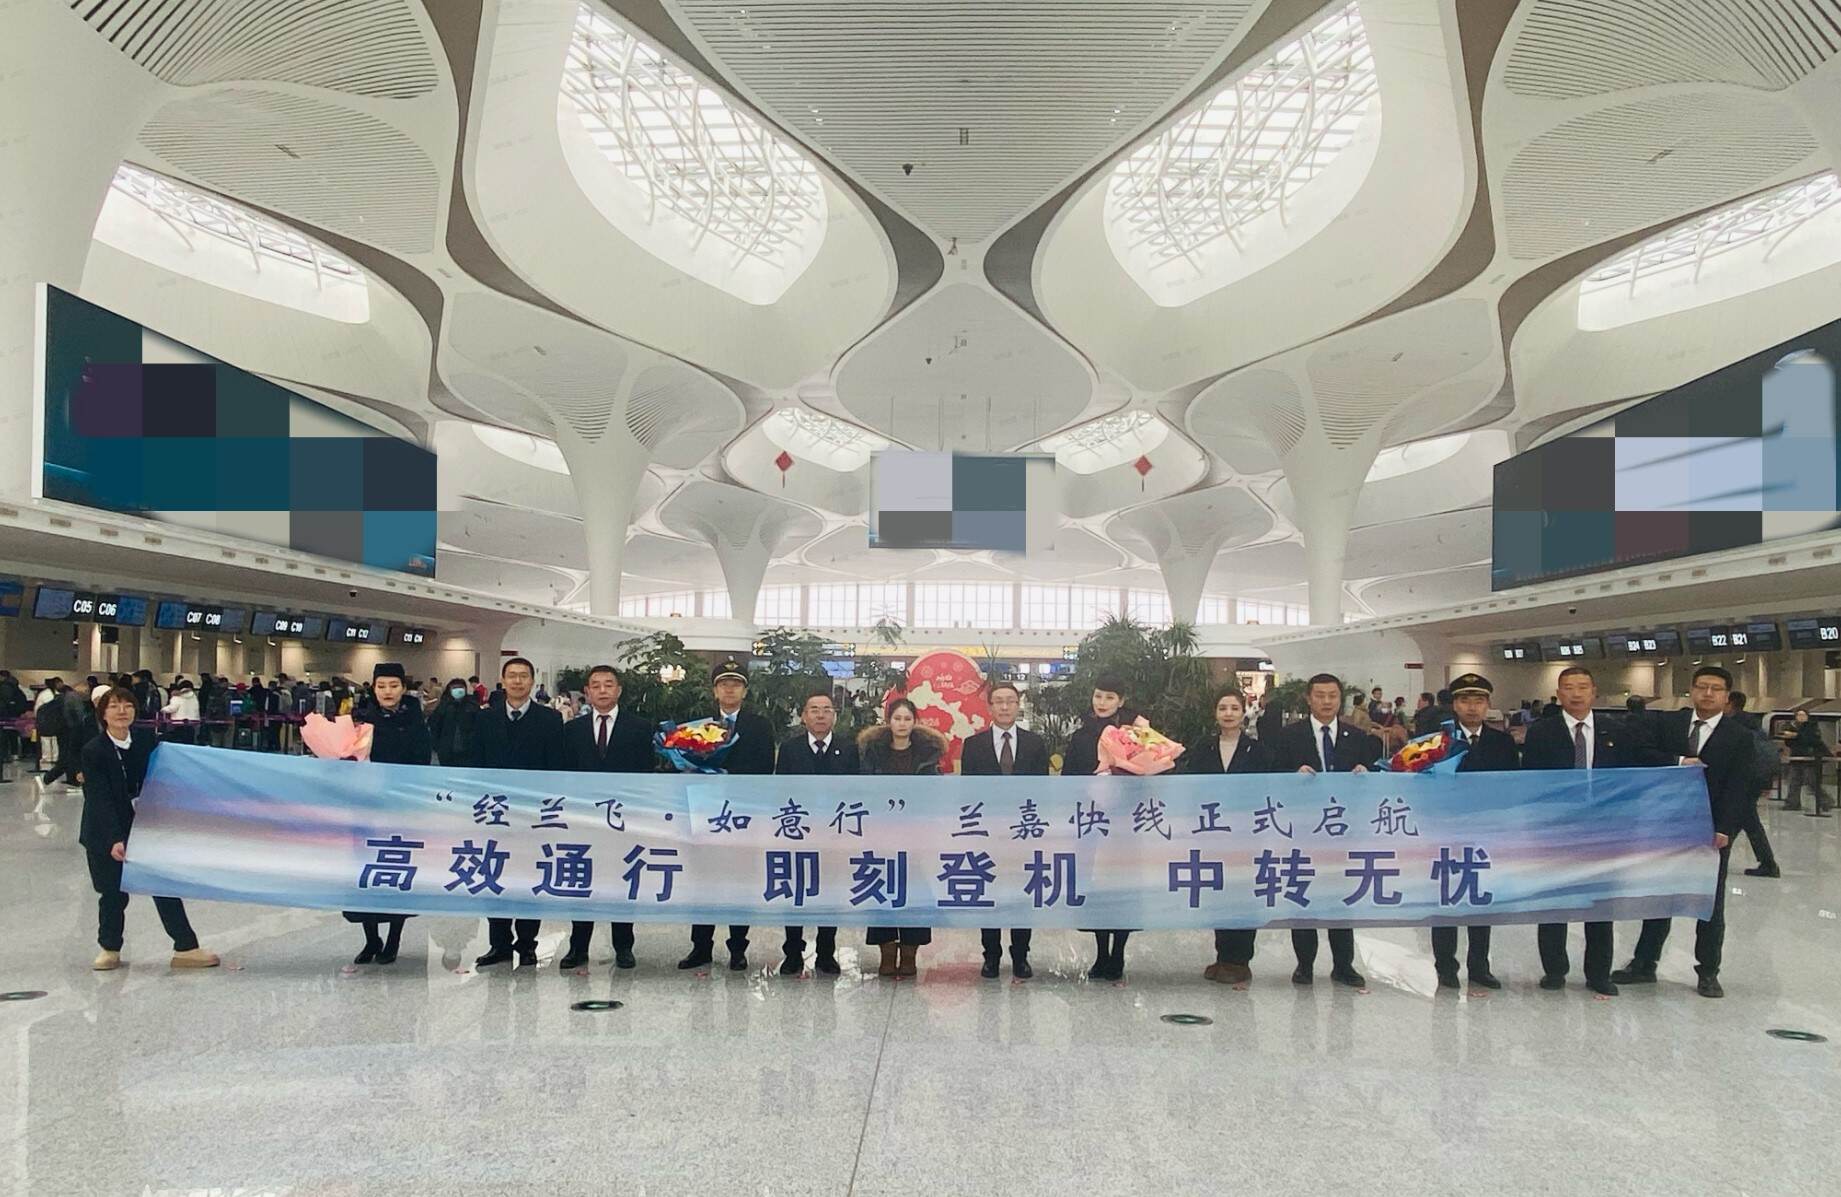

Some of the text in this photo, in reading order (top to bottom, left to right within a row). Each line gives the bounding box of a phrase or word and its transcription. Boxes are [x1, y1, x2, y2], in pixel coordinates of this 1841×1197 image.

[73, 599, 117, 616] C05 C06
[206, 612, 221, 625] C08
[1711, 633, 1748, 646] B22 B21
[1820, 626, 1839, 641] B20
[951, 796, 1420, 840] 兰嘉快线正式启航
[358, 834, 1493, 909] 高效通行 即刻登机 中转无忧
